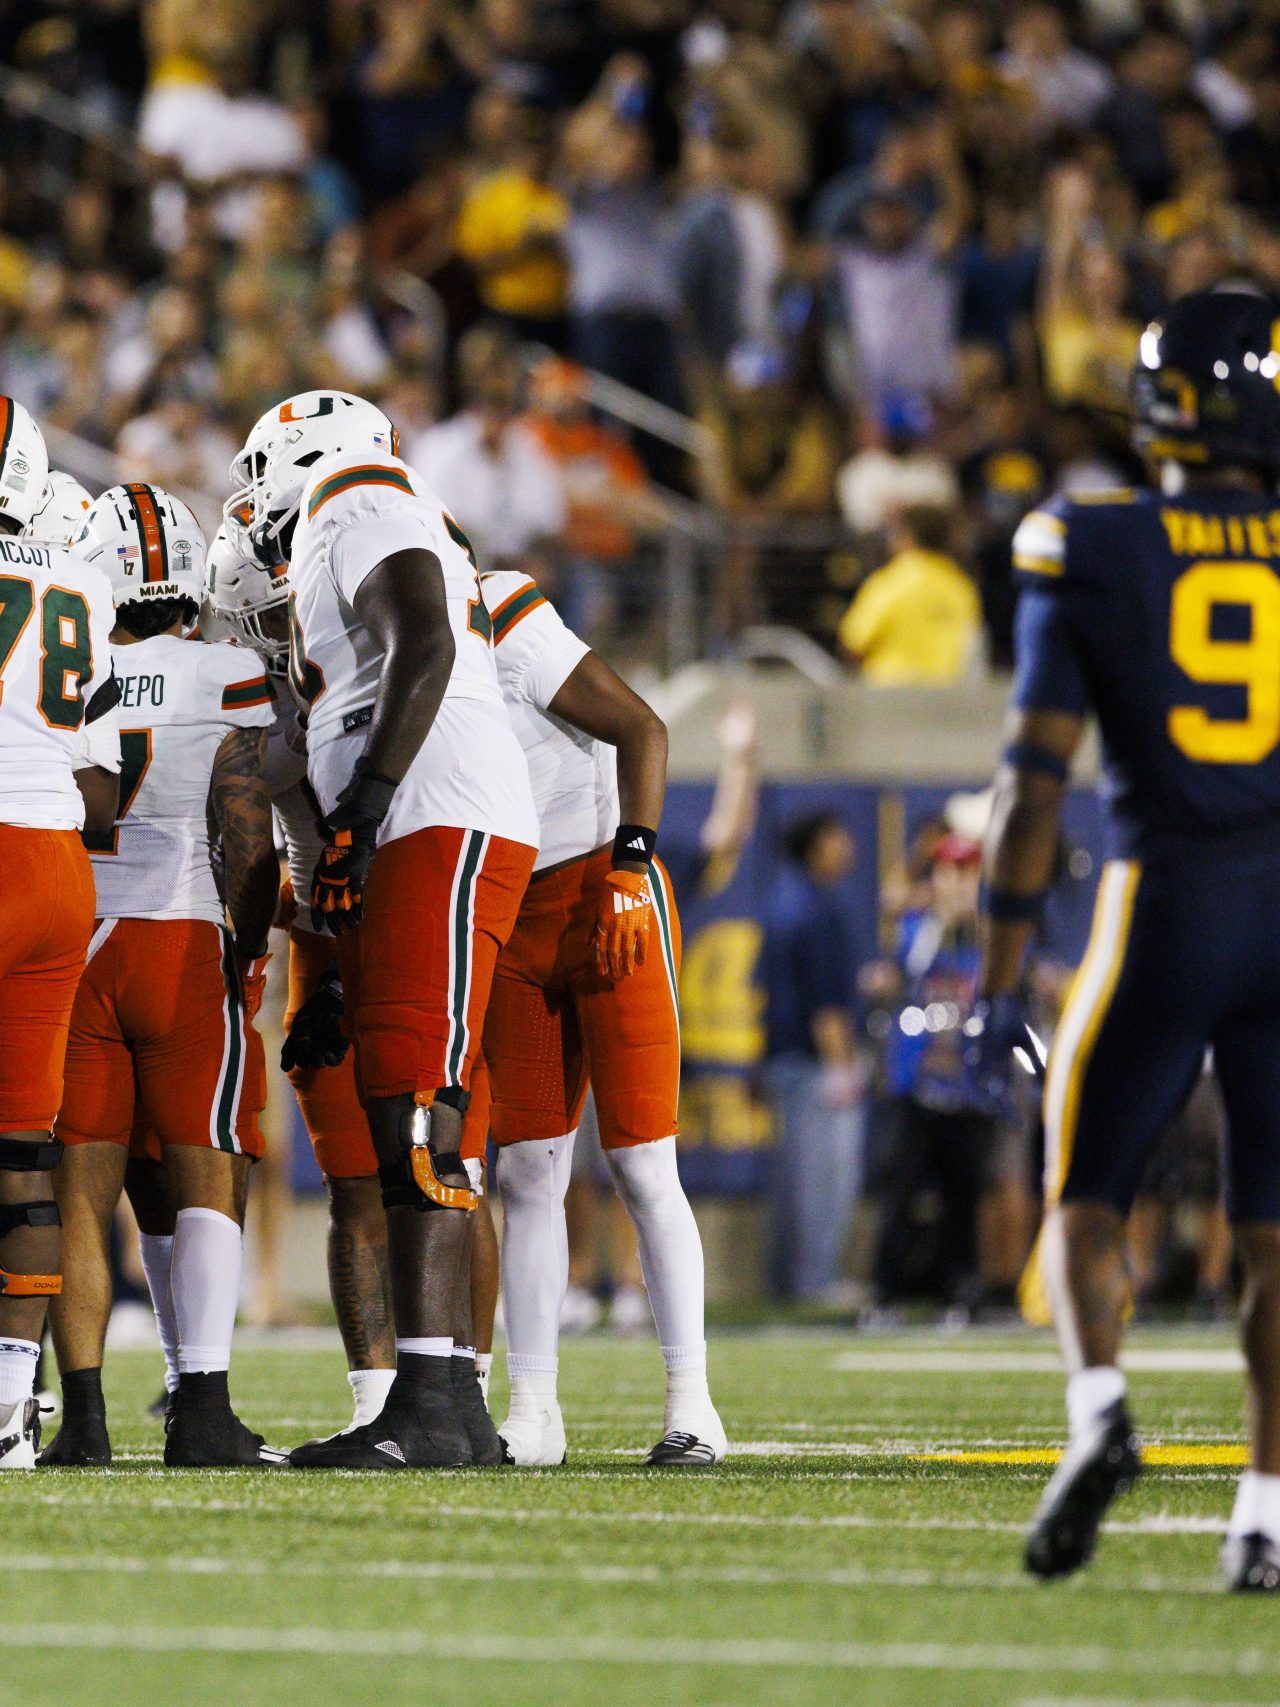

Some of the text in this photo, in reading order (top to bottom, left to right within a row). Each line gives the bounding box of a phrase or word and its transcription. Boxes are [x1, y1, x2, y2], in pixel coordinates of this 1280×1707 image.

[271, 576, 290, 590] MIA
[140, 584, 179, 597] MIAMI
[1166, 560, 1280, 765] 9
